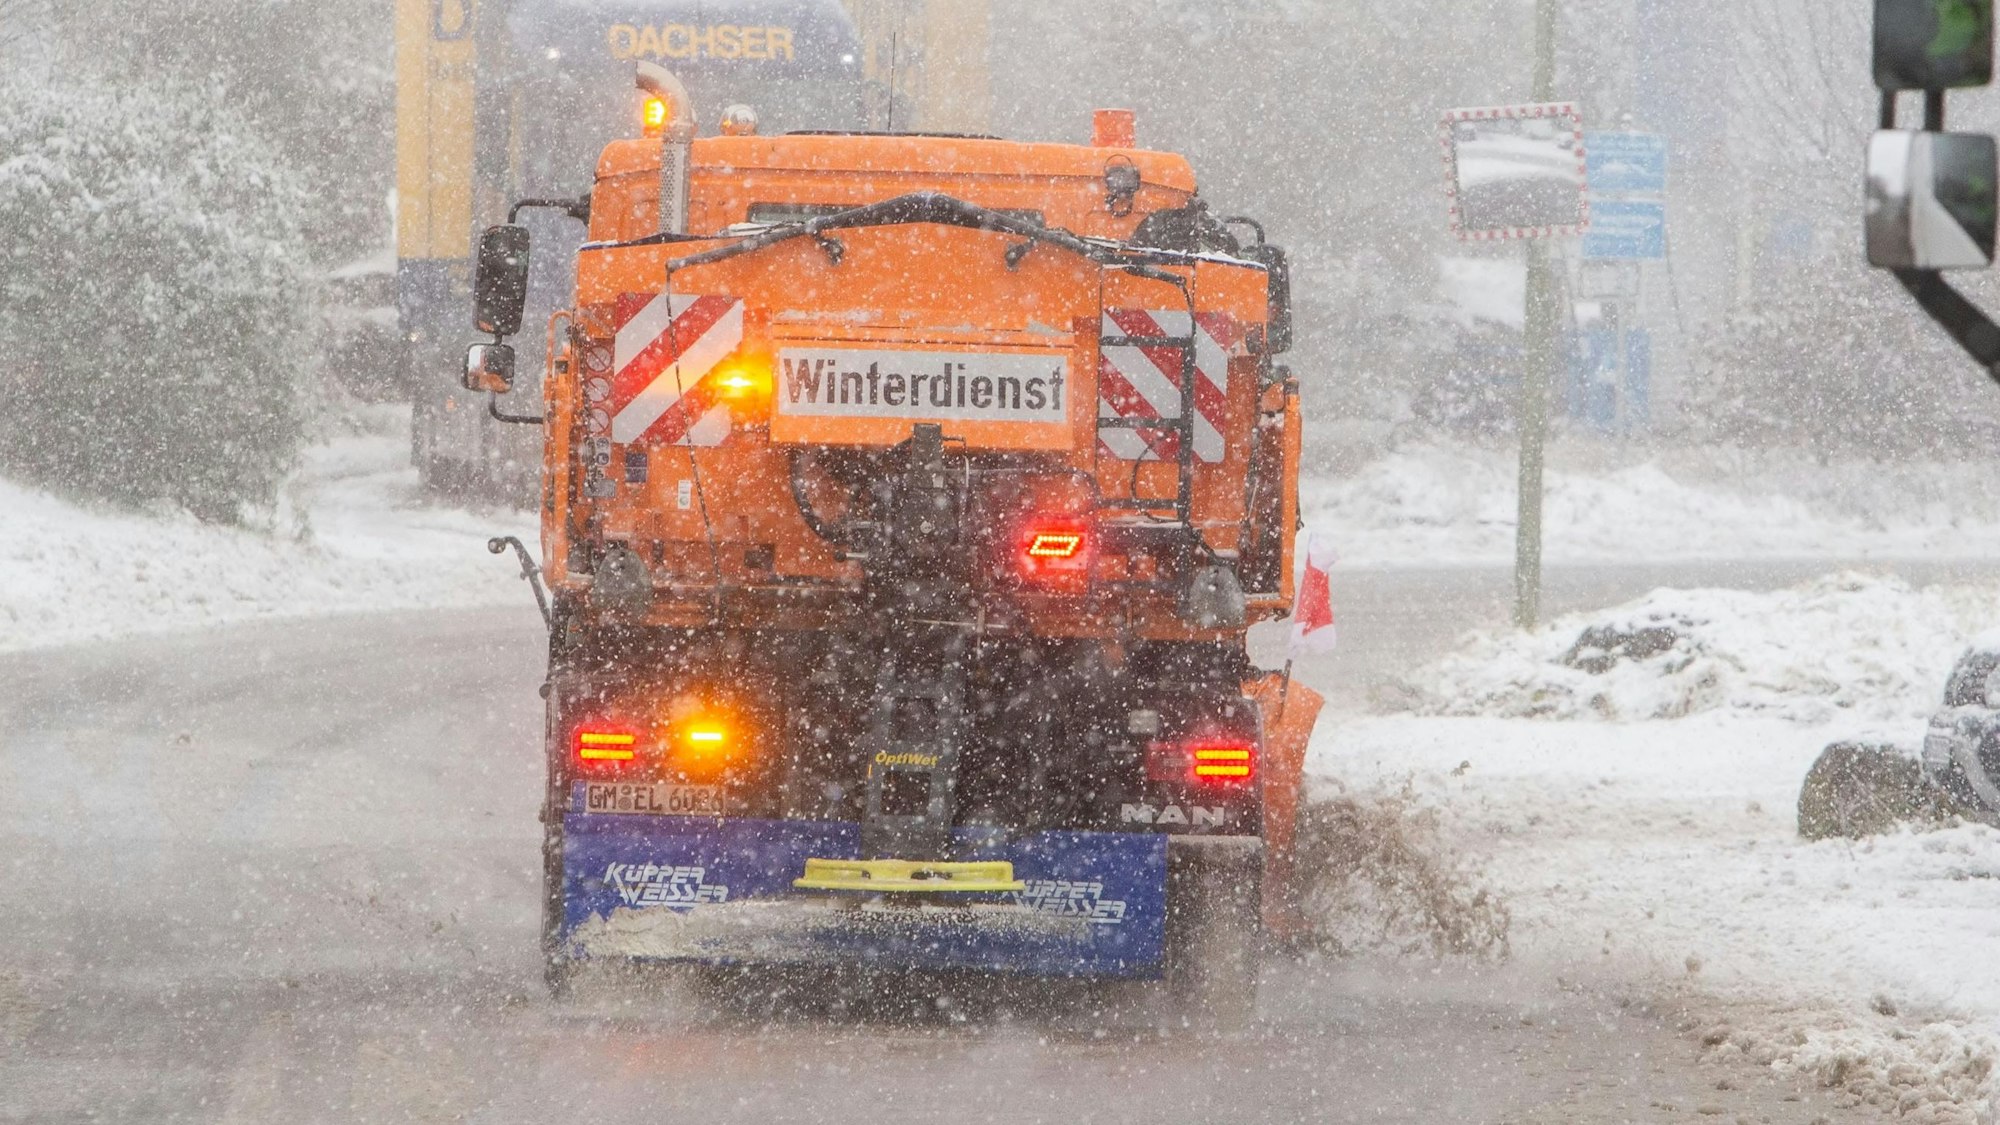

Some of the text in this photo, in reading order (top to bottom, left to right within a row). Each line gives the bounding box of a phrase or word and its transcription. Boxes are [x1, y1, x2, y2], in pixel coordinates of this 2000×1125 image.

[608, 22, 796, 62] DACHSER
[783, 358, 1064, 411] Winterdienst
[875, 752, 938, 768] OptiWet
[588, 785, 617, 809] GM
[634, 786, 662, 811] EL
[1120, 803, 1225, 826] MAN
[603, 861, 706, 884] KÜPPER
